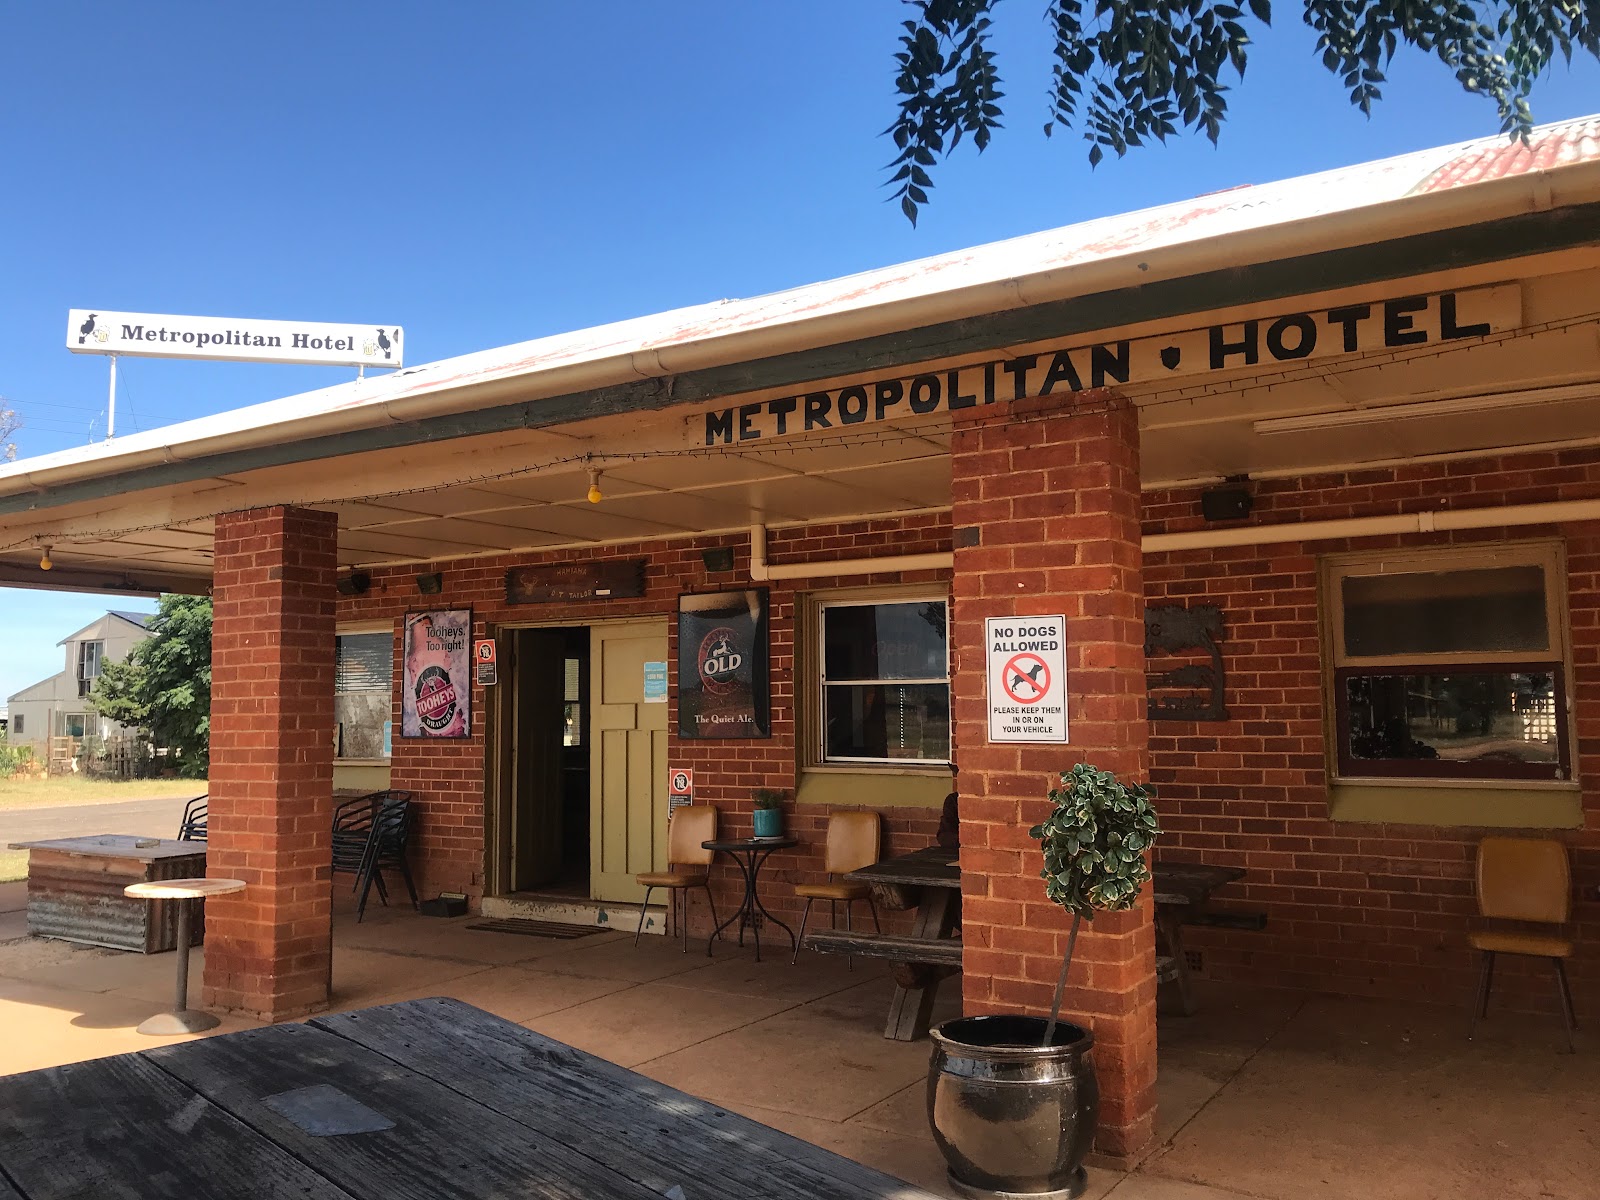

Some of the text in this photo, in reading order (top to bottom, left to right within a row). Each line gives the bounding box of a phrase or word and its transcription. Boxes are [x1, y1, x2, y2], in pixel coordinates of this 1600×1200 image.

[120, 324, 355, 351] Metropolitan Hotel
[704, 292, 1491, 446] METROPOLITAN HOTEL
[425, 626, 466, 640] Tooheys.
[994, 626, 1057, 638] NO DOGS
[426, 639, 465, 653] Too right!
[993, 640, 1059, 652] ALLOWED
[704, 653, 742, 675] OLD
[416, 687, 455, 713] TOOHEYS
[993, 706, 1062, 714] PLEASE KEEP THEM
[426, 707, 454, 728] DRAUGHT
[694, 714, 754, 725] The Quiet Ale.
[1012, 716, 1044, 724] IN OR ON
[1002, 725, 1053, 733] YOUR VEHICLE
